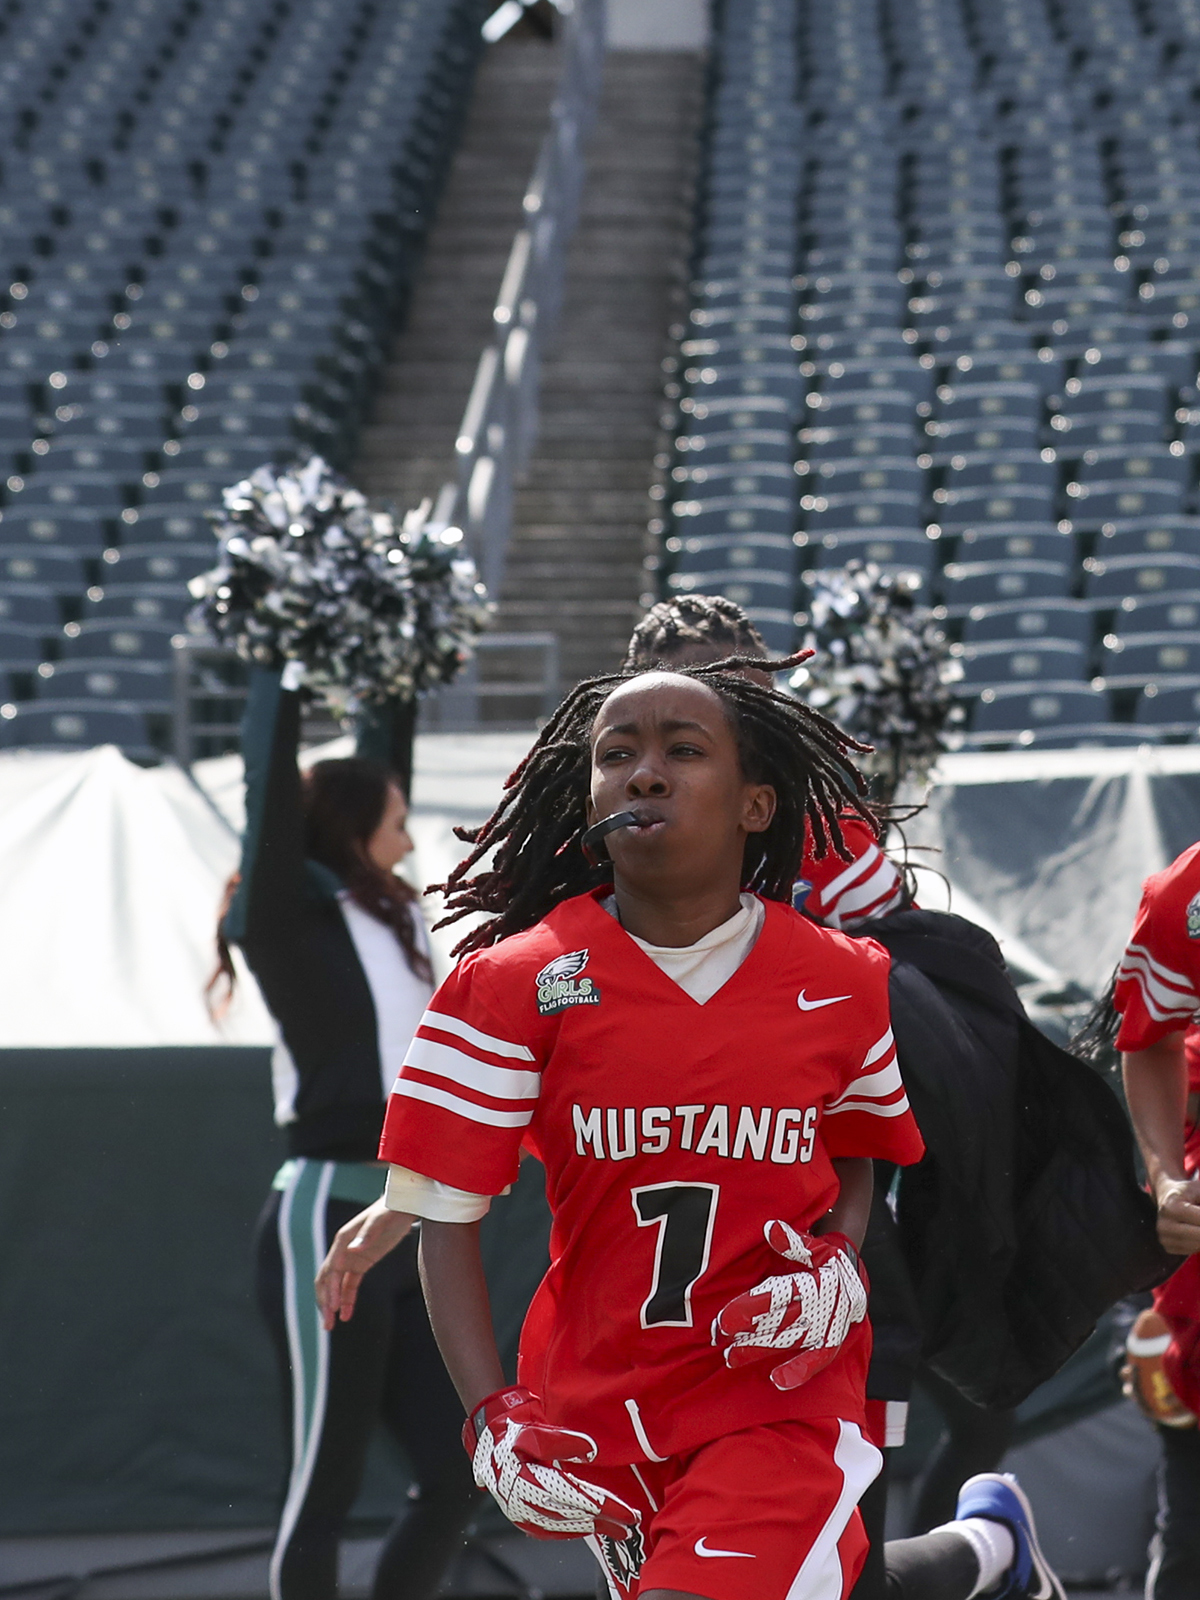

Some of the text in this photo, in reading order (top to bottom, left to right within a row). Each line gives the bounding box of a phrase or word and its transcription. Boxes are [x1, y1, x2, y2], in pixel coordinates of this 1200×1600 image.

[538, 978, 592, 1002] GIRLS
[539, 995, 599, 1013] FLAG FOOTBALL
[572, 1104, 817, 1165] MUSTANGS
